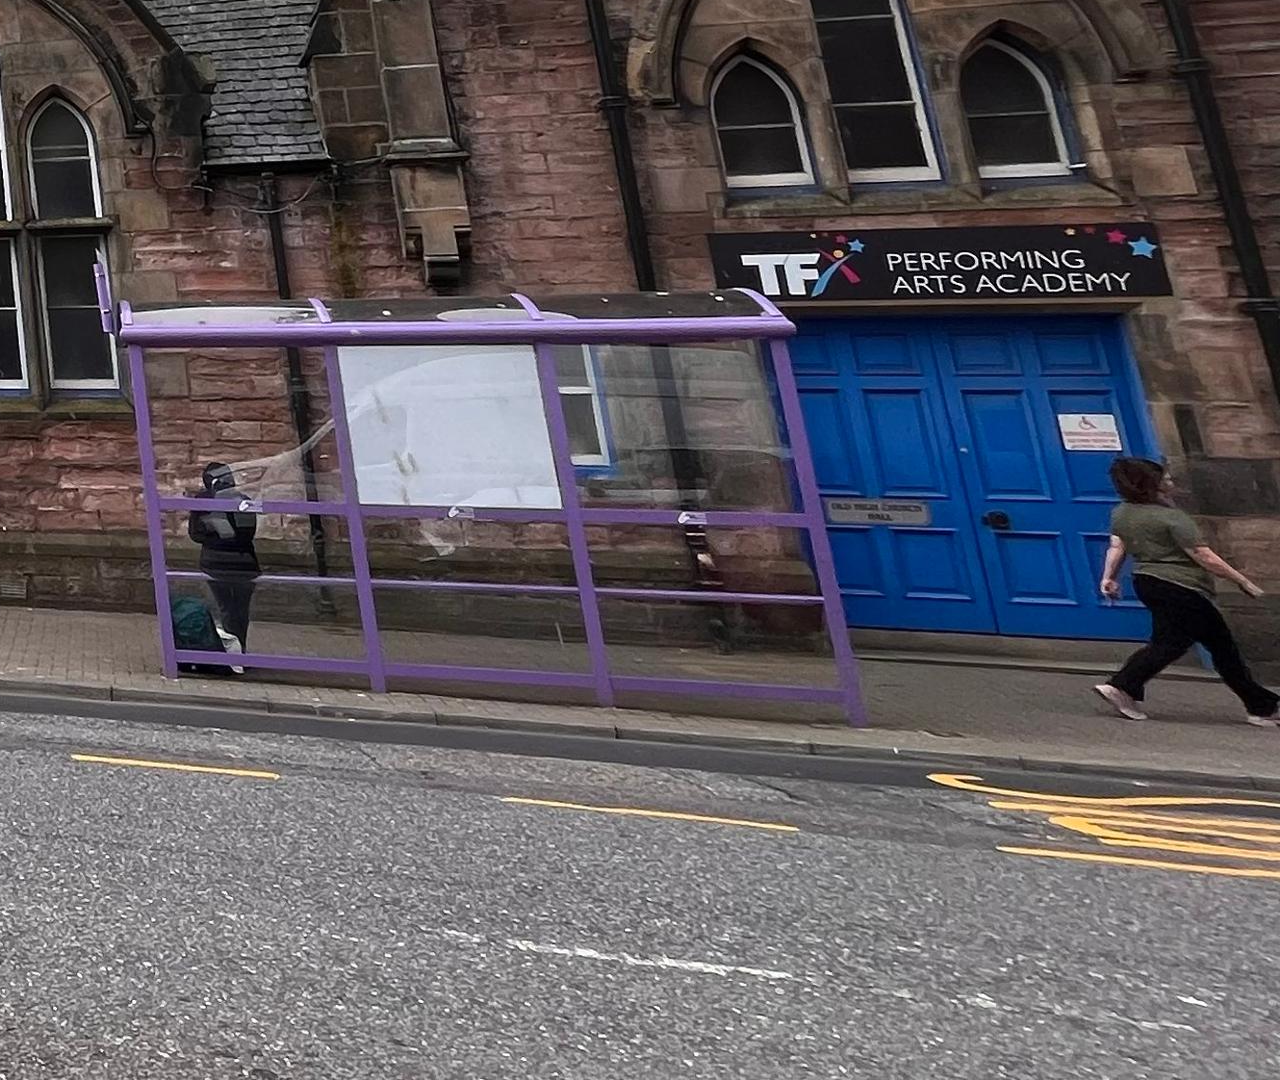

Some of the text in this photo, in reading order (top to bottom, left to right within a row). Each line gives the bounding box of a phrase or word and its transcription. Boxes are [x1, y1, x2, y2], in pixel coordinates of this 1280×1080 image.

[886, 249, 1087, 272] PERFORMING
[892, 271, 1132, 295] ARTS ACADEMY
